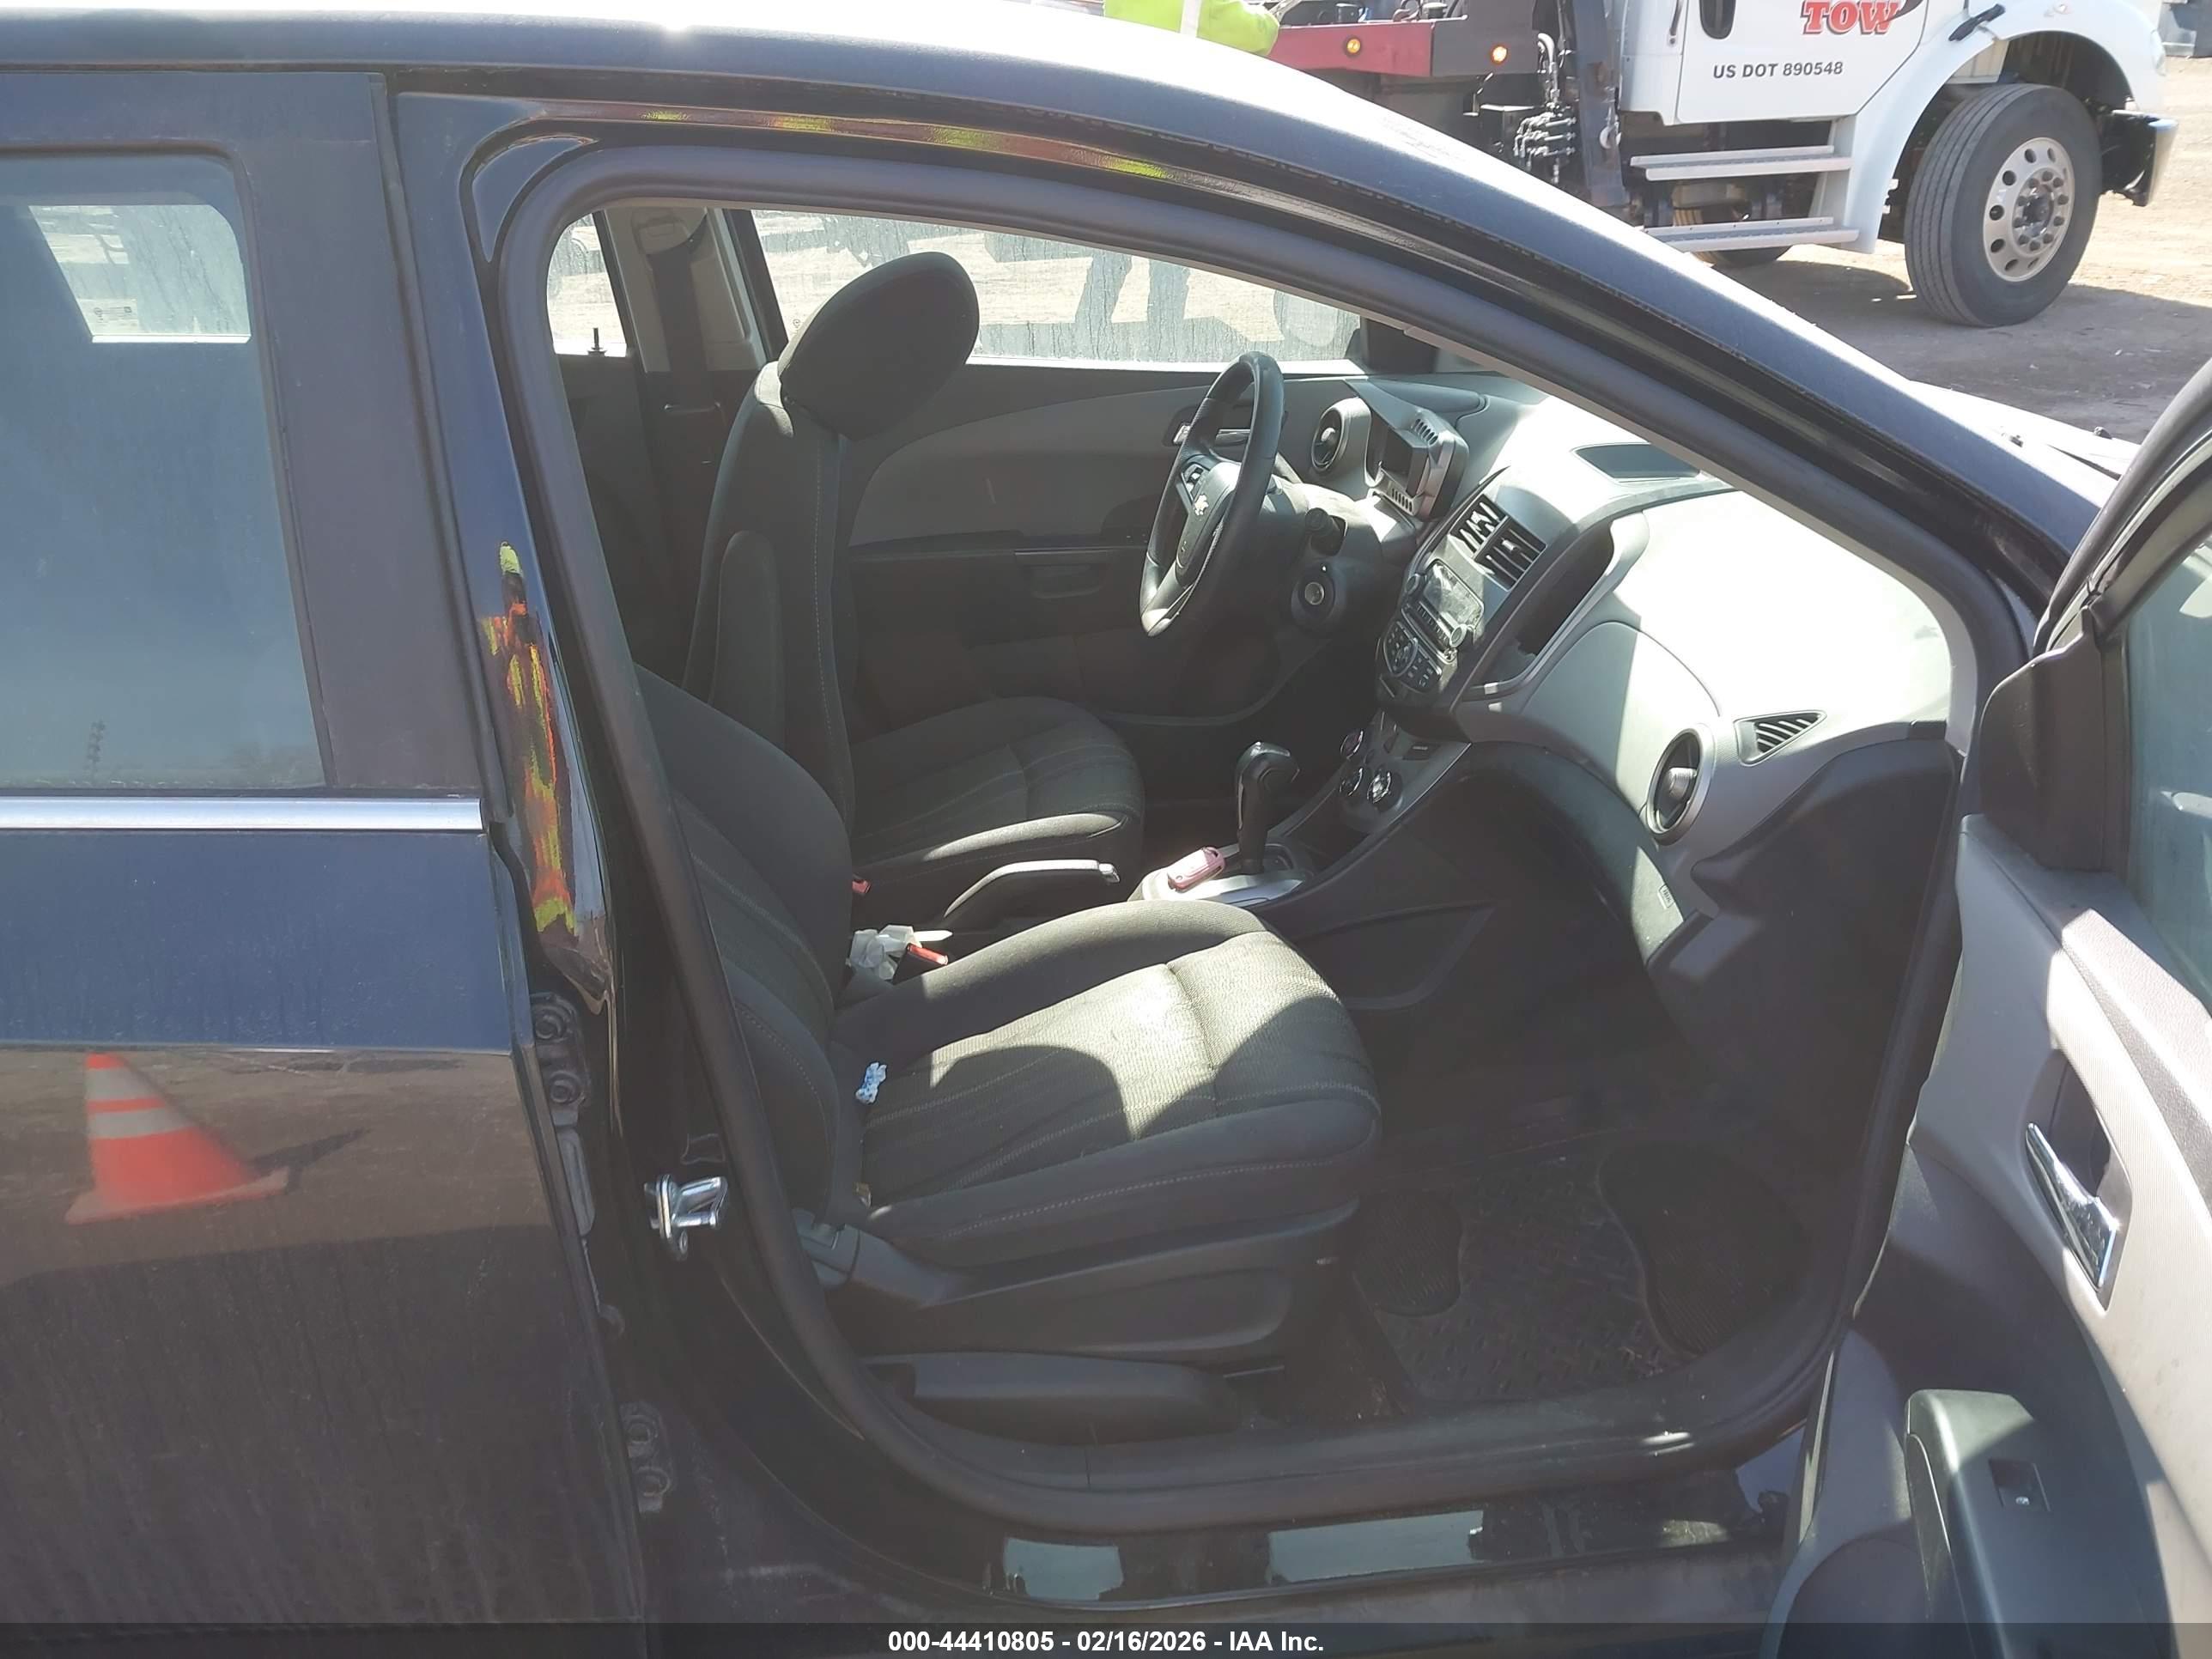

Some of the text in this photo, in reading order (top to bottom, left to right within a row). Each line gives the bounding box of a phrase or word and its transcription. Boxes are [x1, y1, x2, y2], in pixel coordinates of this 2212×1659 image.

[1801, 1, 1901, 34] TOW
[1713, 61, 1843, 78] US DOT 890548
